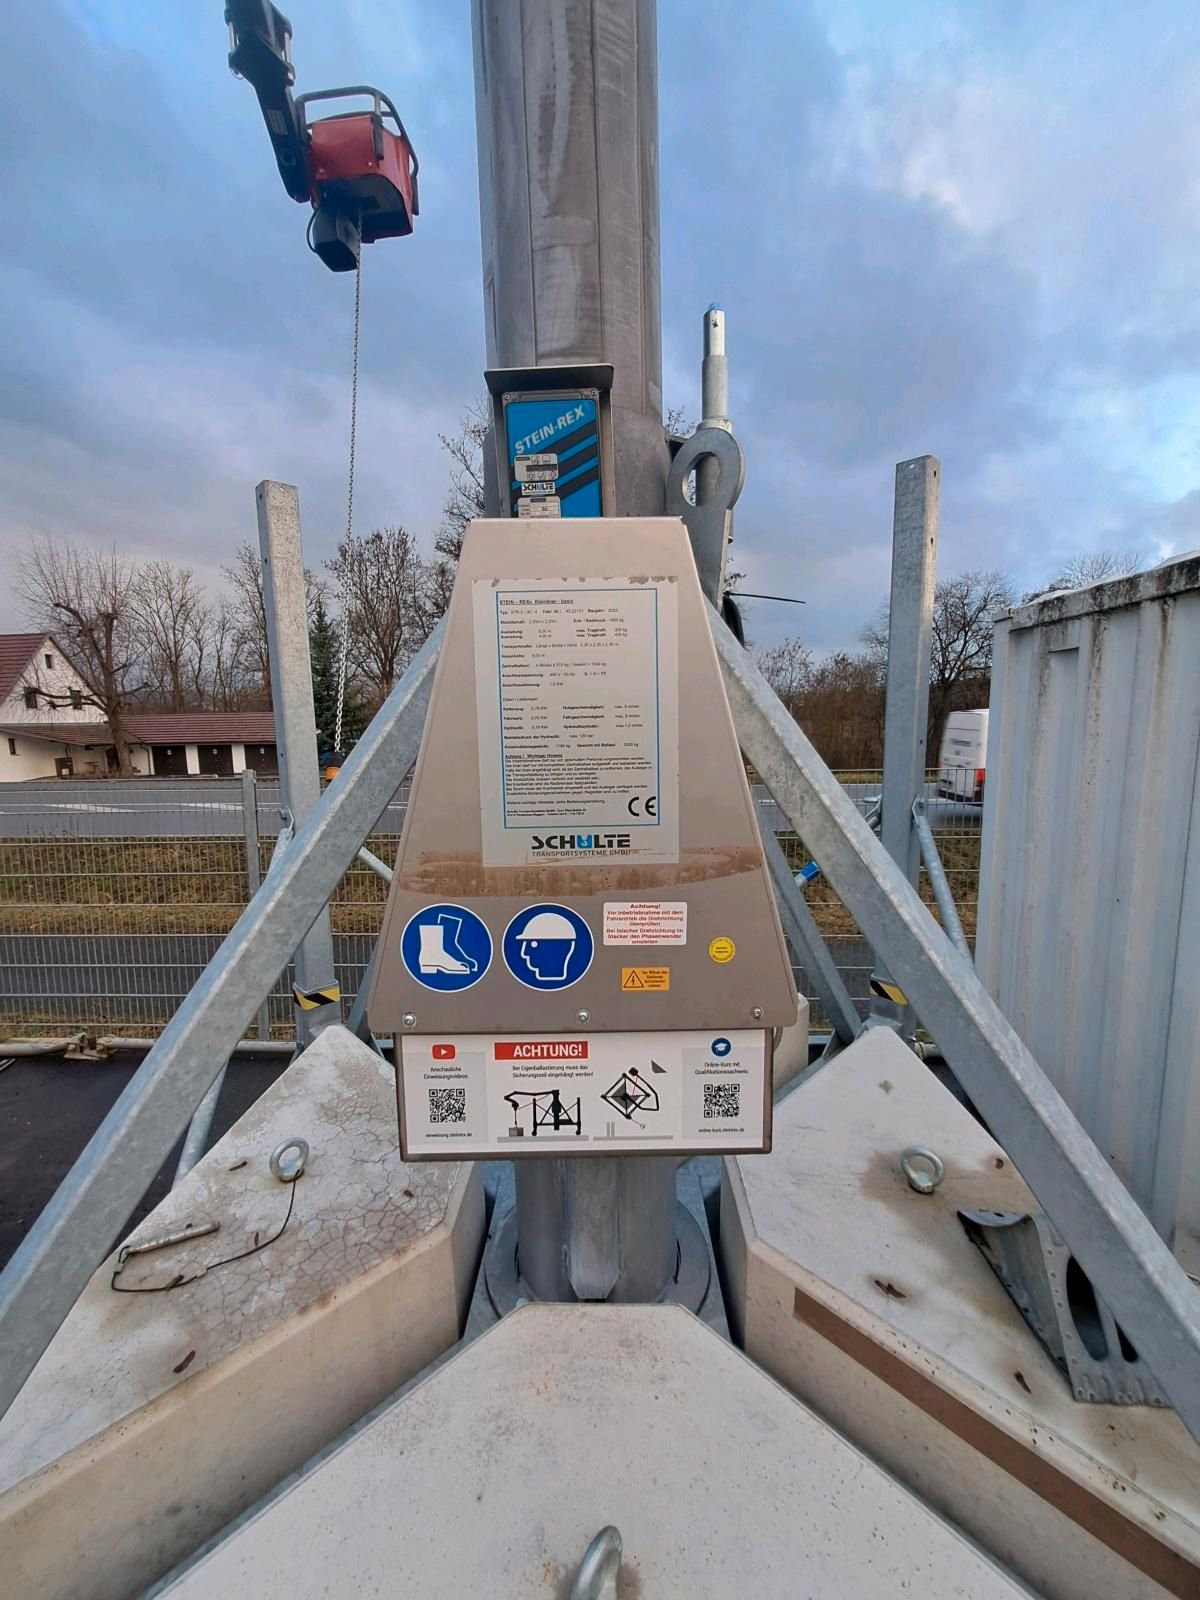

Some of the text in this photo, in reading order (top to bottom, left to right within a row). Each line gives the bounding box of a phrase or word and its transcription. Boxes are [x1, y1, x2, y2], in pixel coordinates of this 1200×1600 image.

[514, 404, 585, 454] STEIN-REX
[523, 483, 554, 491] SCHULTE
[532, 834, 631, 850] SCHULTE
[513, 1043, 582, 1058] ACHTUNG!
